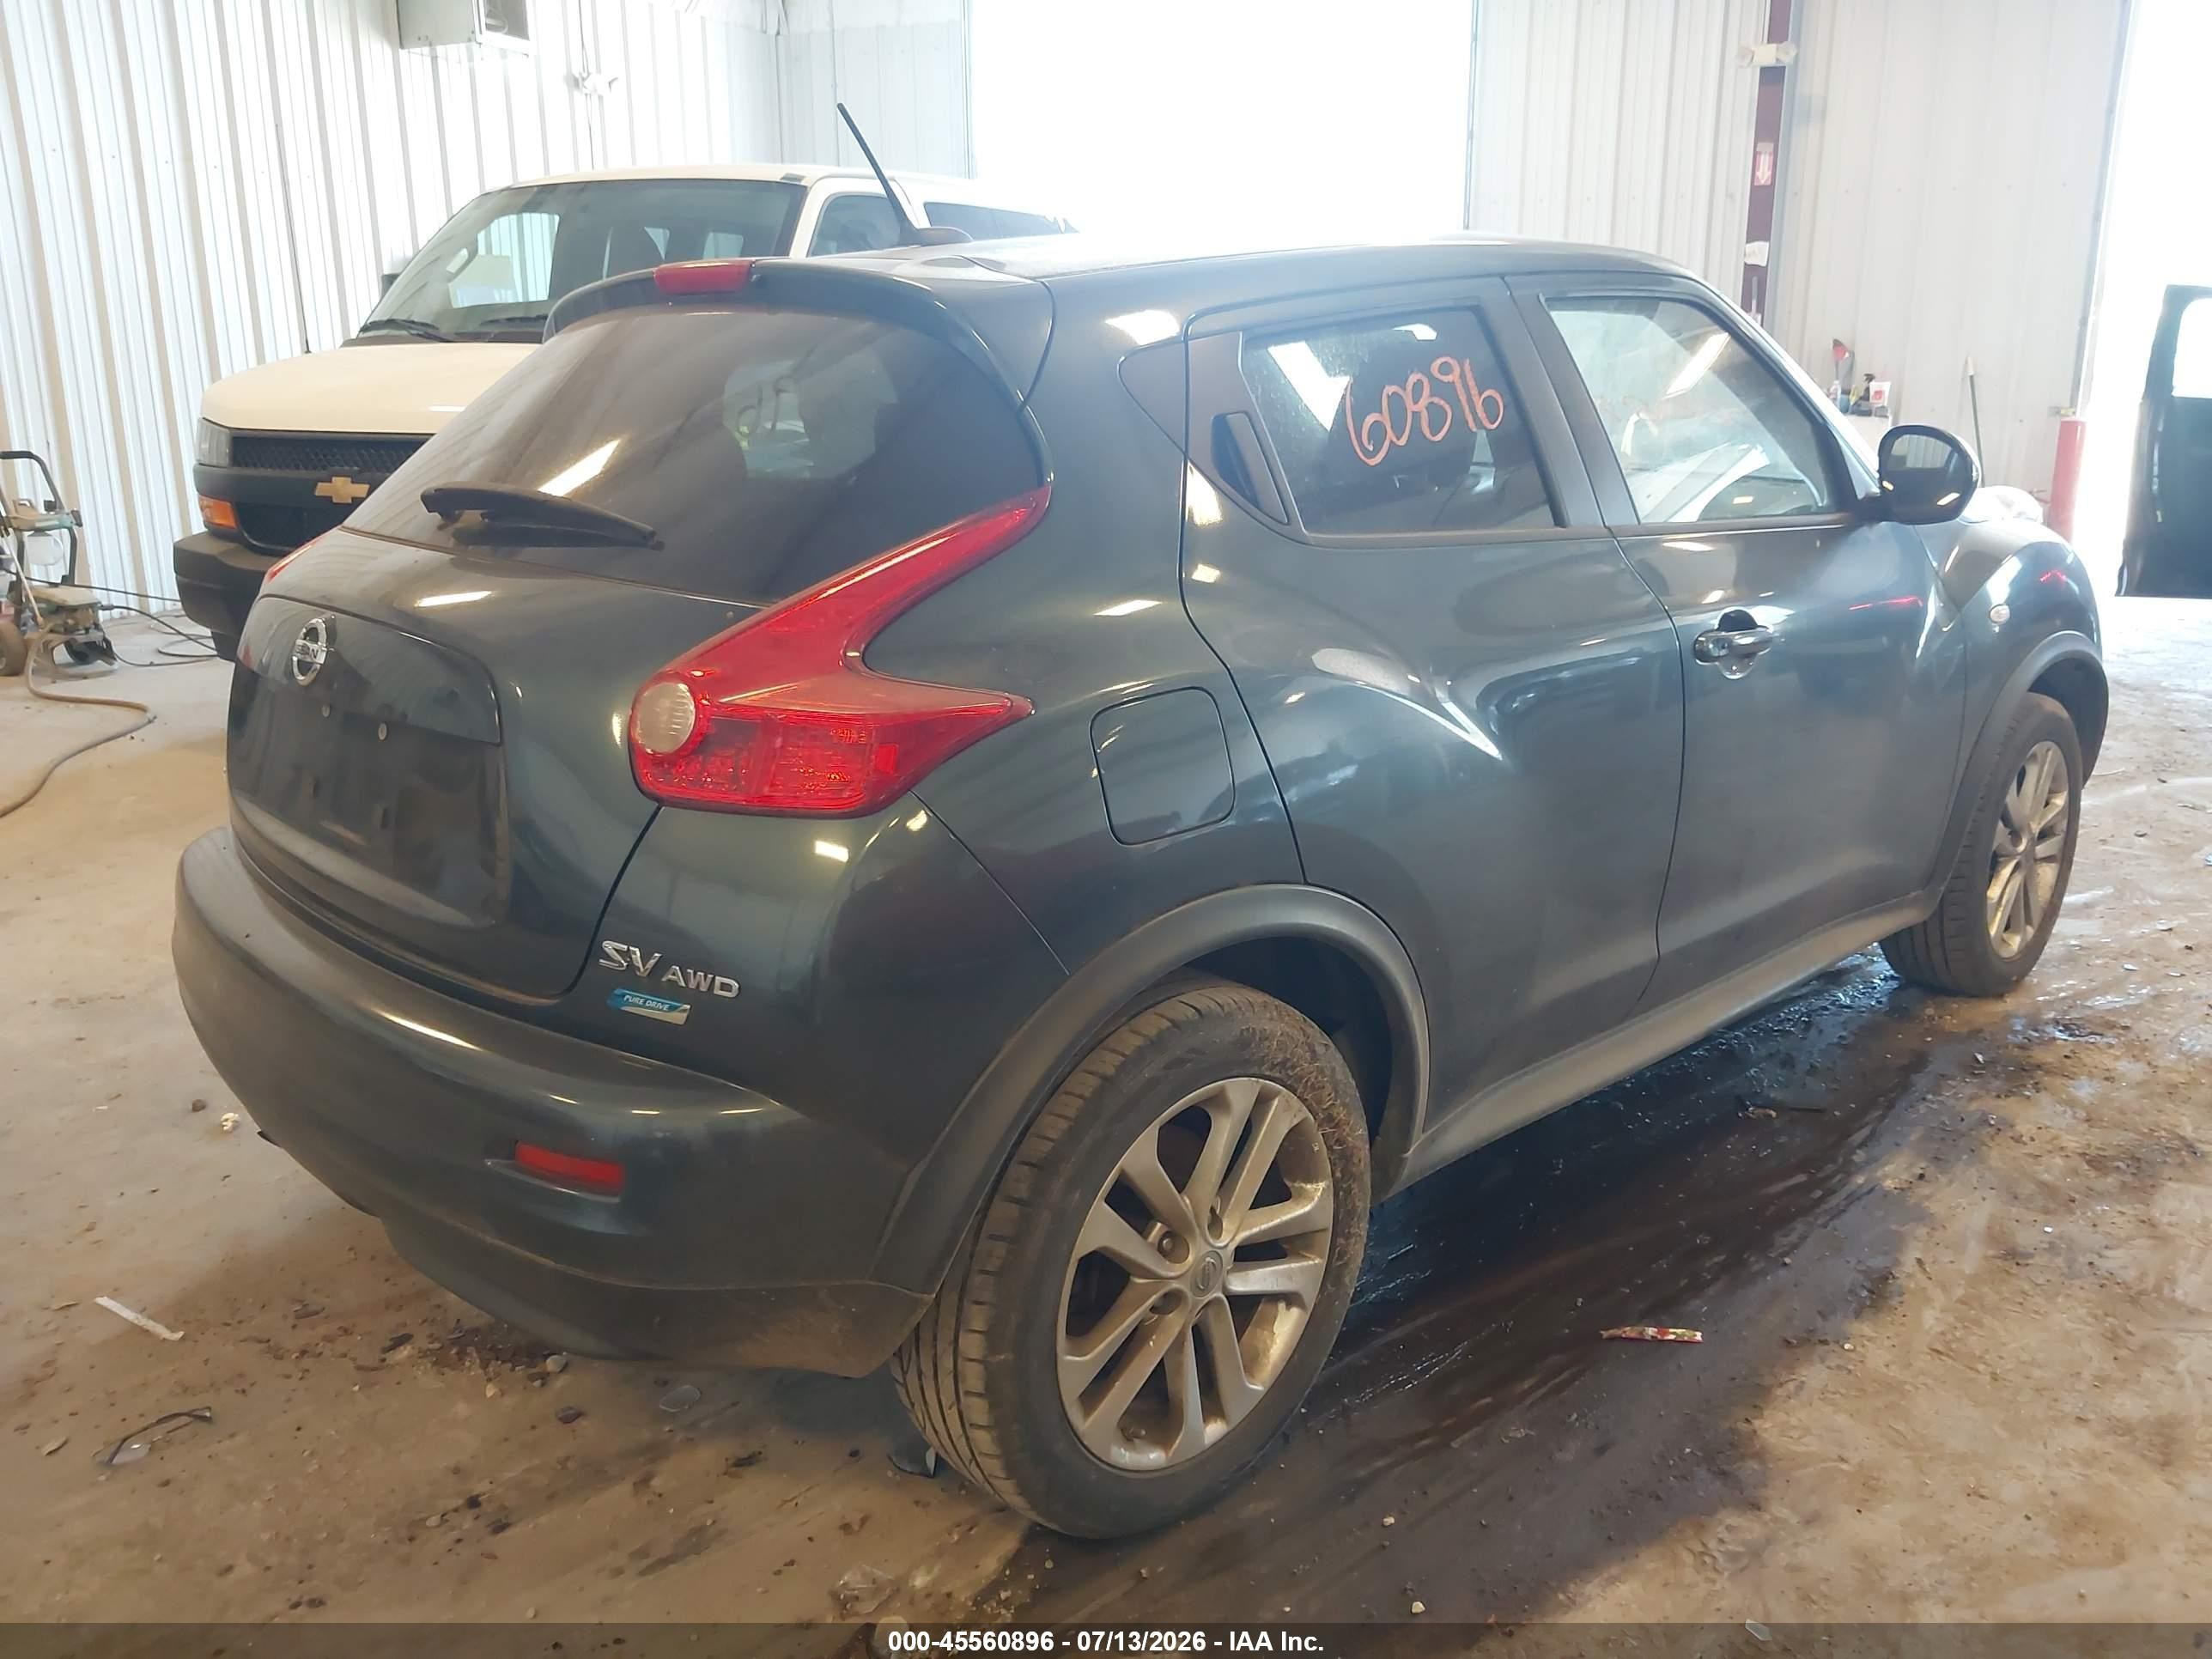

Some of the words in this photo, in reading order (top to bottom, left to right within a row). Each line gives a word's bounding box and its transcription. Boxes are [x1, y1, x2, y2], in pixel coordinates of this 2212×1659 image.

[1345, 356, 1504, 466] 60896
[599, 940, 662, 977] SV
[661, 965, 740, 998] AWD
[623, 994, 644, 1006] PURE
[644, 1000, 670, 1012] DRIVE
